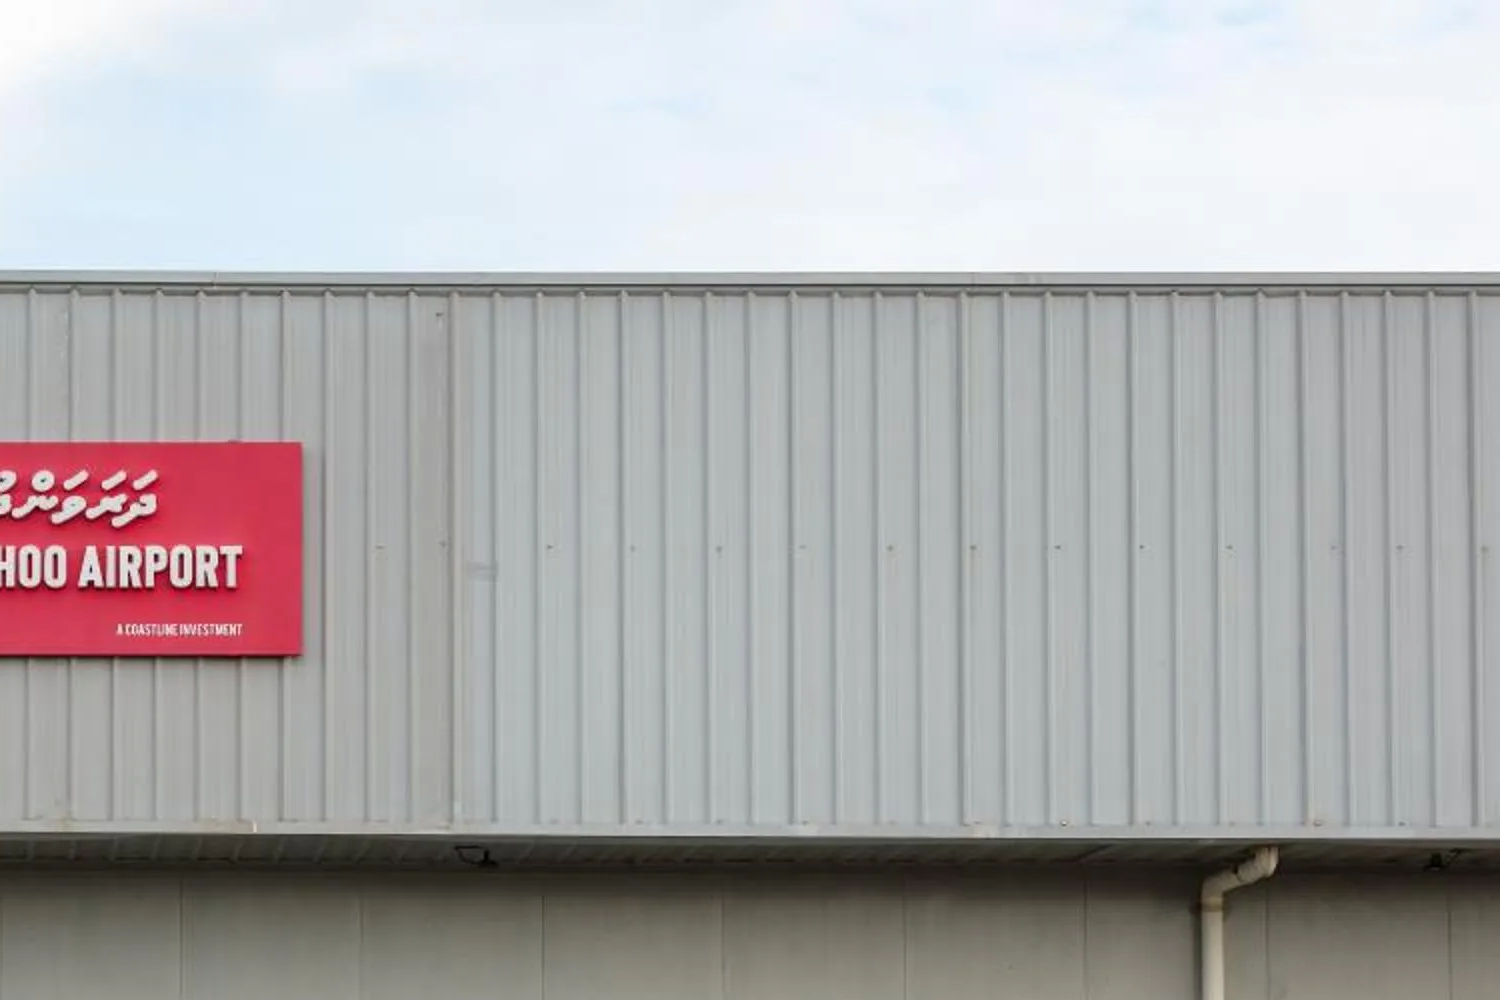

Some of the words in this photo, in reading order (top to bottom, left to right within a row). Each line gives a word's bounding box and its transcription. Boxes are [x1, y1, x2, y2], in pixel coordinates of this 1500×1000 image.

[77, 543, 243, 588] AIRPORT
[115, 622, 124, 637] A
[125, 622, 178, 637] COASTLINE
[179, 622, 243, 637] INVESTMENT
